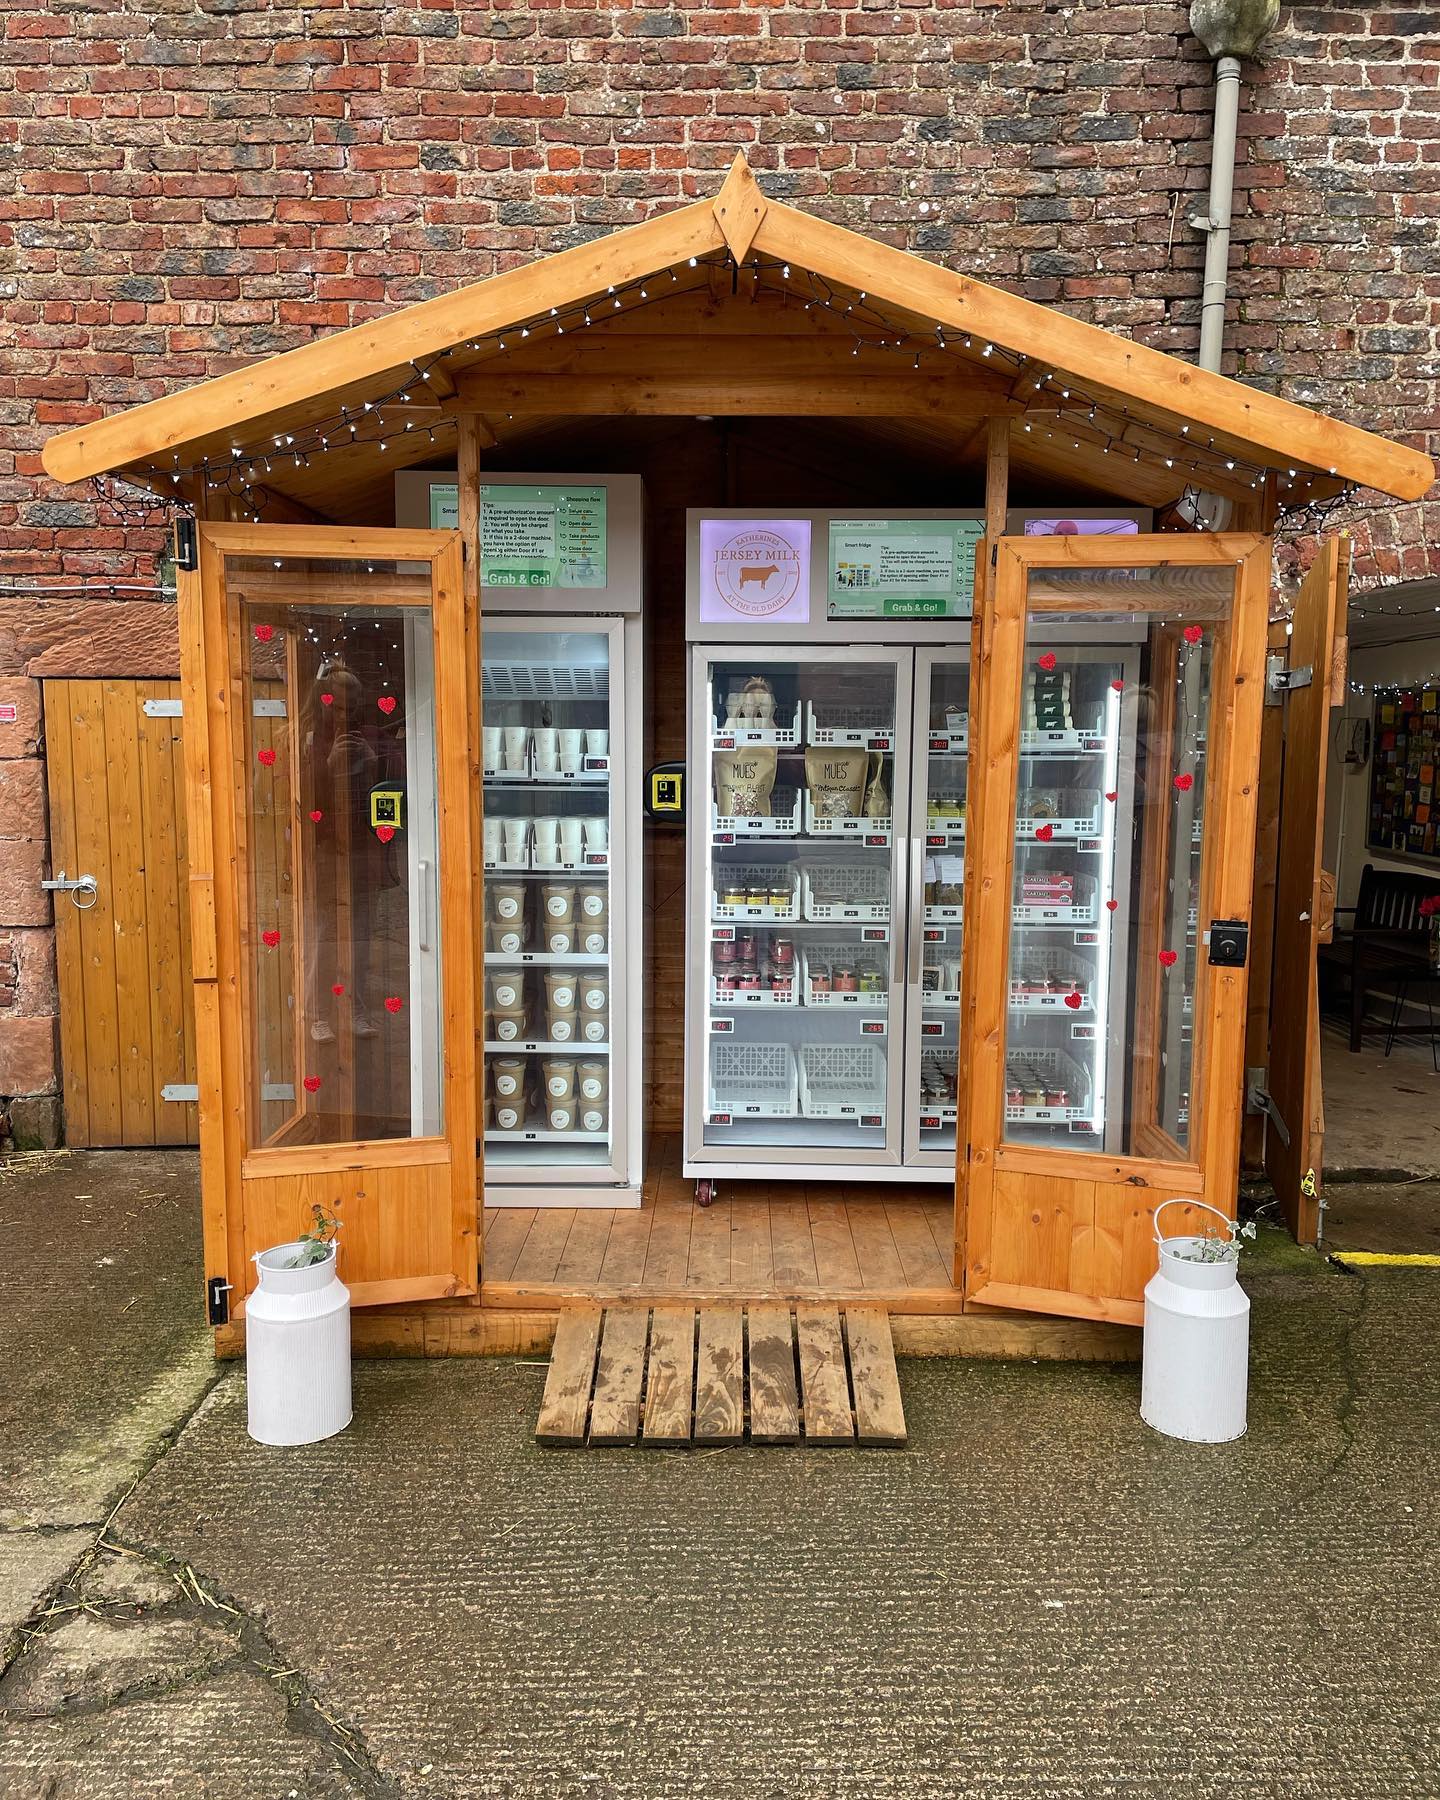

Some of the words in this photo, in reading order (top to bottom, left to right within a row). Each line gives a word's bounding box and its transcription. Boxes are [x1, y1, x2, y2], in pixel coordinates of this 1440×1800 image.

[735, 534, 780, 547] KATHERINES
[713, 550, 762, 563] JERSEY
[765, 550, 801, 561] MILK
[489, 573, 516, 585] Grab
[519, 574, 528, 585] &
[530, 574, 550, 585] Go!
[727, 594, 736, 602] AT
[737, 601, 750, 611] THE
[752, 604, 766, 612] OLD
[767, 595, 786, 610] DAIRY
[892, 603, 912, 612] Grab
[914, 604, 921, 612] &
[923, 603, 938, 612] Go!
[732, 764, 755, 780] MUES
[824, 763, 848, 780] MUES
